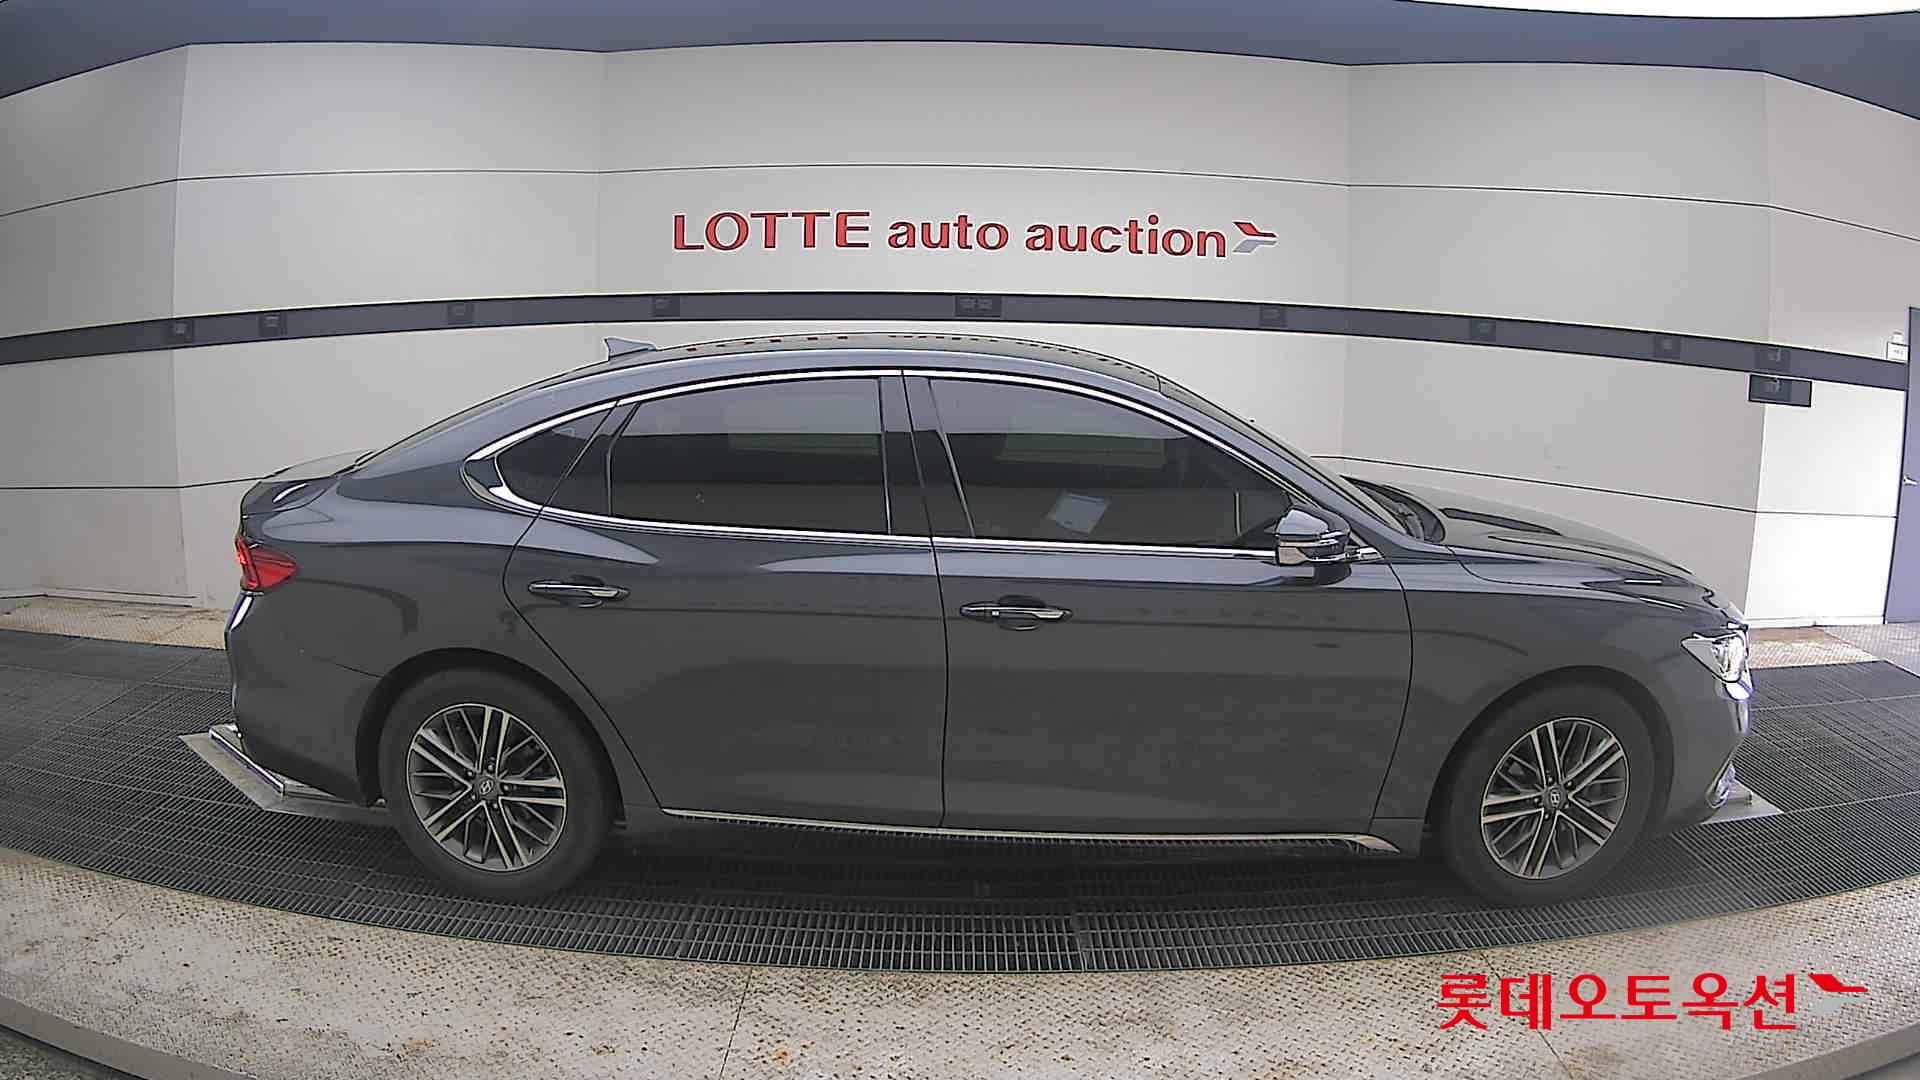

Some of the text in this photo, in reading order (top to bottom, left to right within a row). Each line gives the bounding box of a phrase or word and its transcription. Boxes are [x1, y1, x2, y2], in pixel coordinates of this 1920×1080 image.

[673, 211, 1227, 257] LOTTE auto auction
